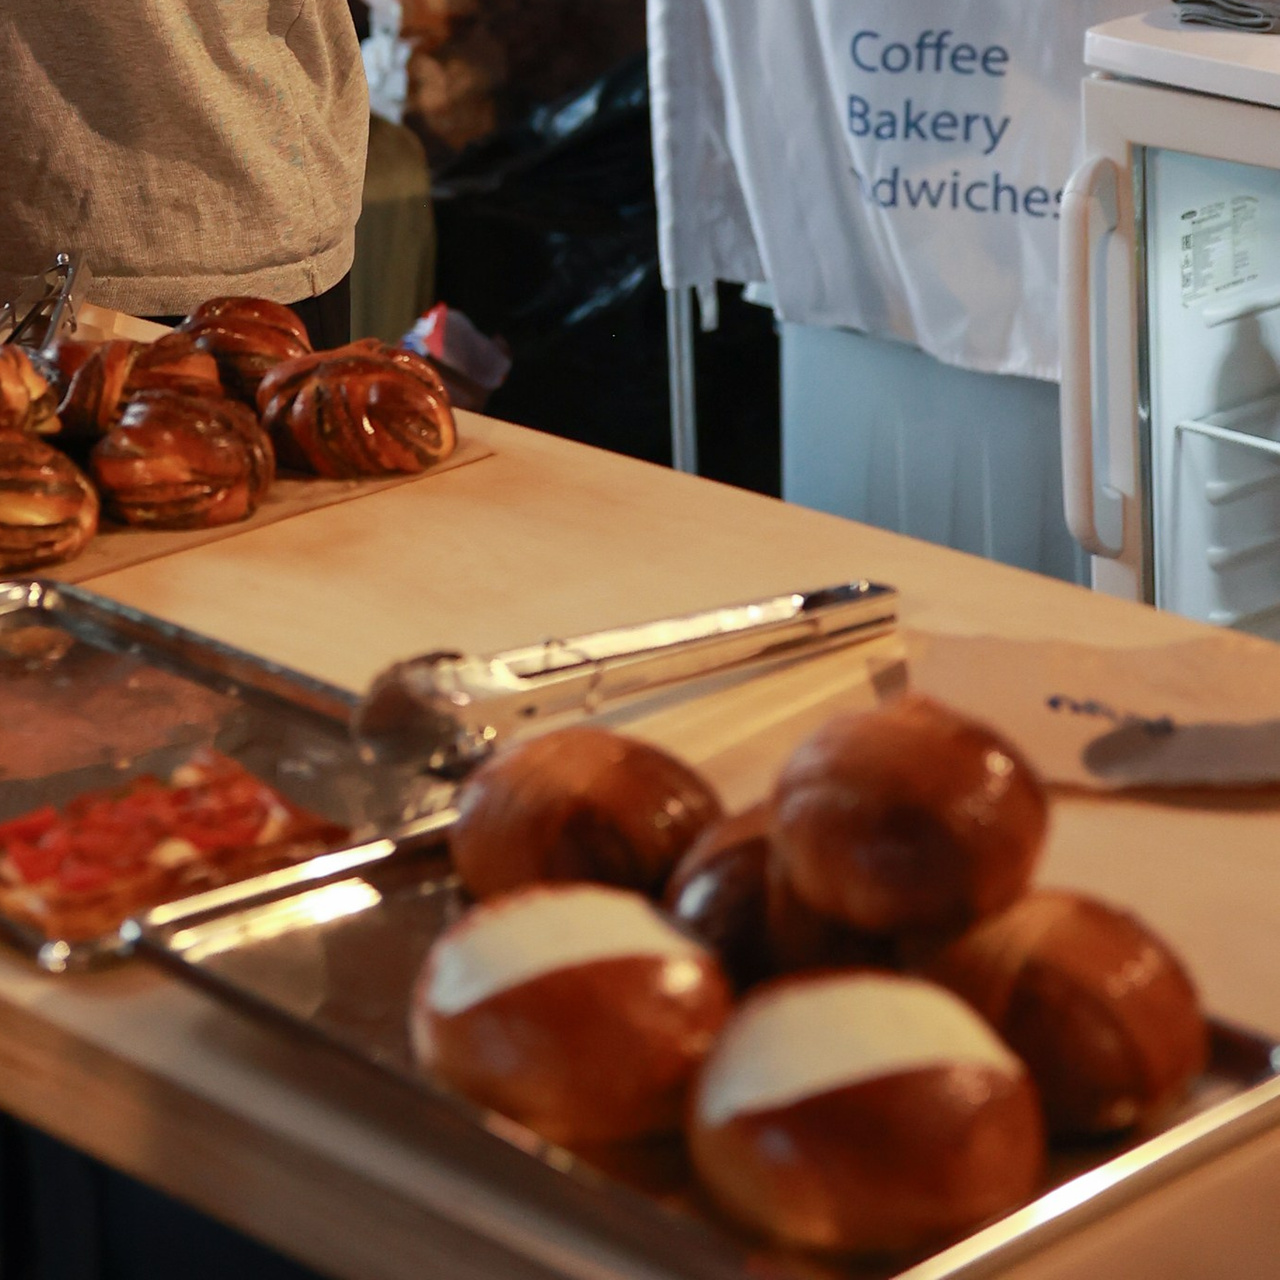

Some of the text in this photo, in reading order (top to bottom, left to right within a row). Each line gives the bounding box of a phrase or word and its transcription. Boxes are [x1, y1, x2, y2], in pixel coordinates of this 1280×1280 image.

[849, 29, 1011, 77] Coffee
[846, 93, 1012, 156] Bakery
[851, 166, 1063, 219] dwiche
